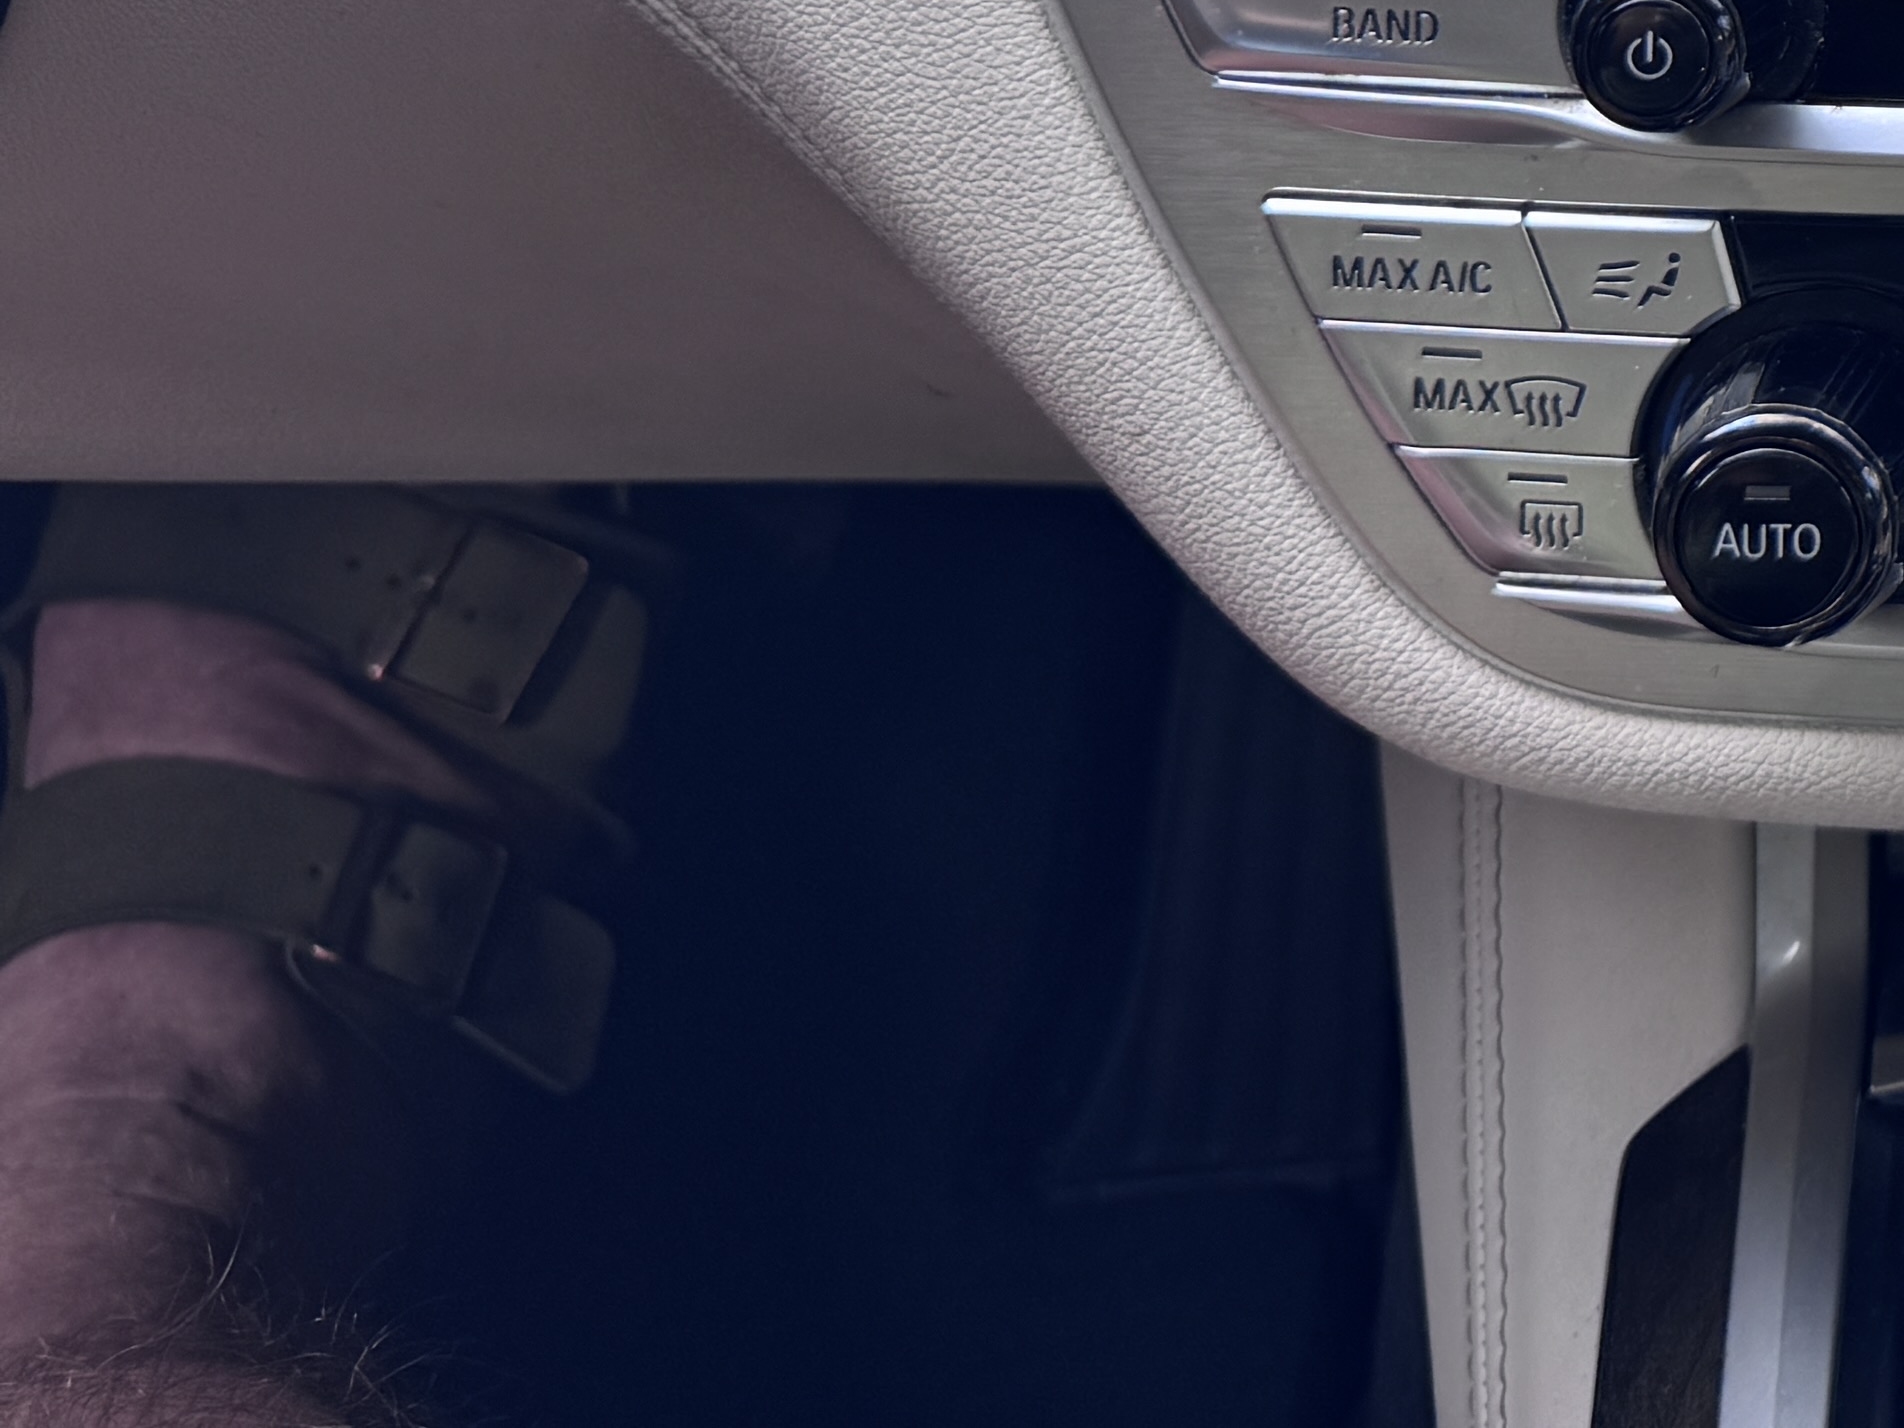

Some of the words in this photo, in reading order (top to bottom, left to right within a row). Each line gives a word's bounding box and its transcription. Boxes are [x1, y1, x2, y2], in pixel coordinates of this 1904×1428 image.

[1331, 6, 1439, 46] BAND
[1332, 255, 1418, 293] MAX
[1431, 261, 1493, 294] A/C
[1413, 377, 1502, 415] MAX
[1714, 522, 1822, 562] AUTO
